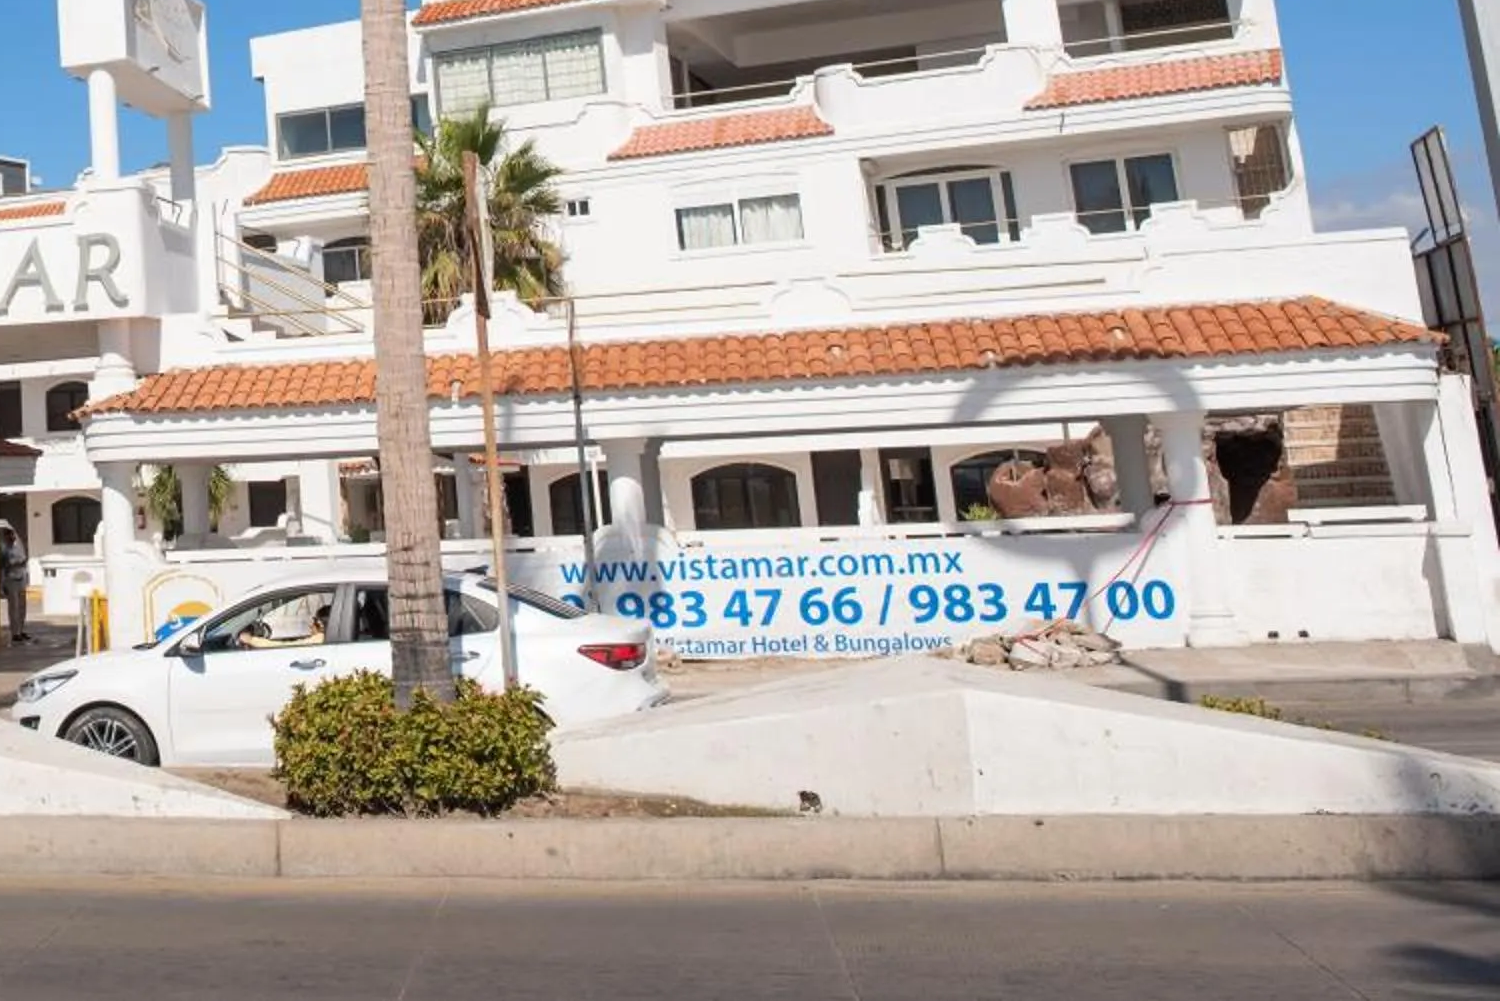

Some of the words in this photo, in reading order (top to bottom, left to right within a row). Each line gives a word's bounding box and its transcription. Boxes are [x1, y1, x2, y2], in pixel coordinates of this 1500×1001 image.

[560, 551, 963, 583] www.vistamar.com.mx
[616, 590, 707, 628] 983
[723, 588, 782, 627] 47
[799, 586, 863, 626] 66
[878, 584, 893, 626] /
[908, 583, 1008, 624] 983
[1024, 581, 1088, 620] 47
[1106, 580, 1175, 620] 00
[752, 634, 808, 653] Hotel
[813, 634, 829, 652] &
[835, 632, 953, 655] Bungalows
